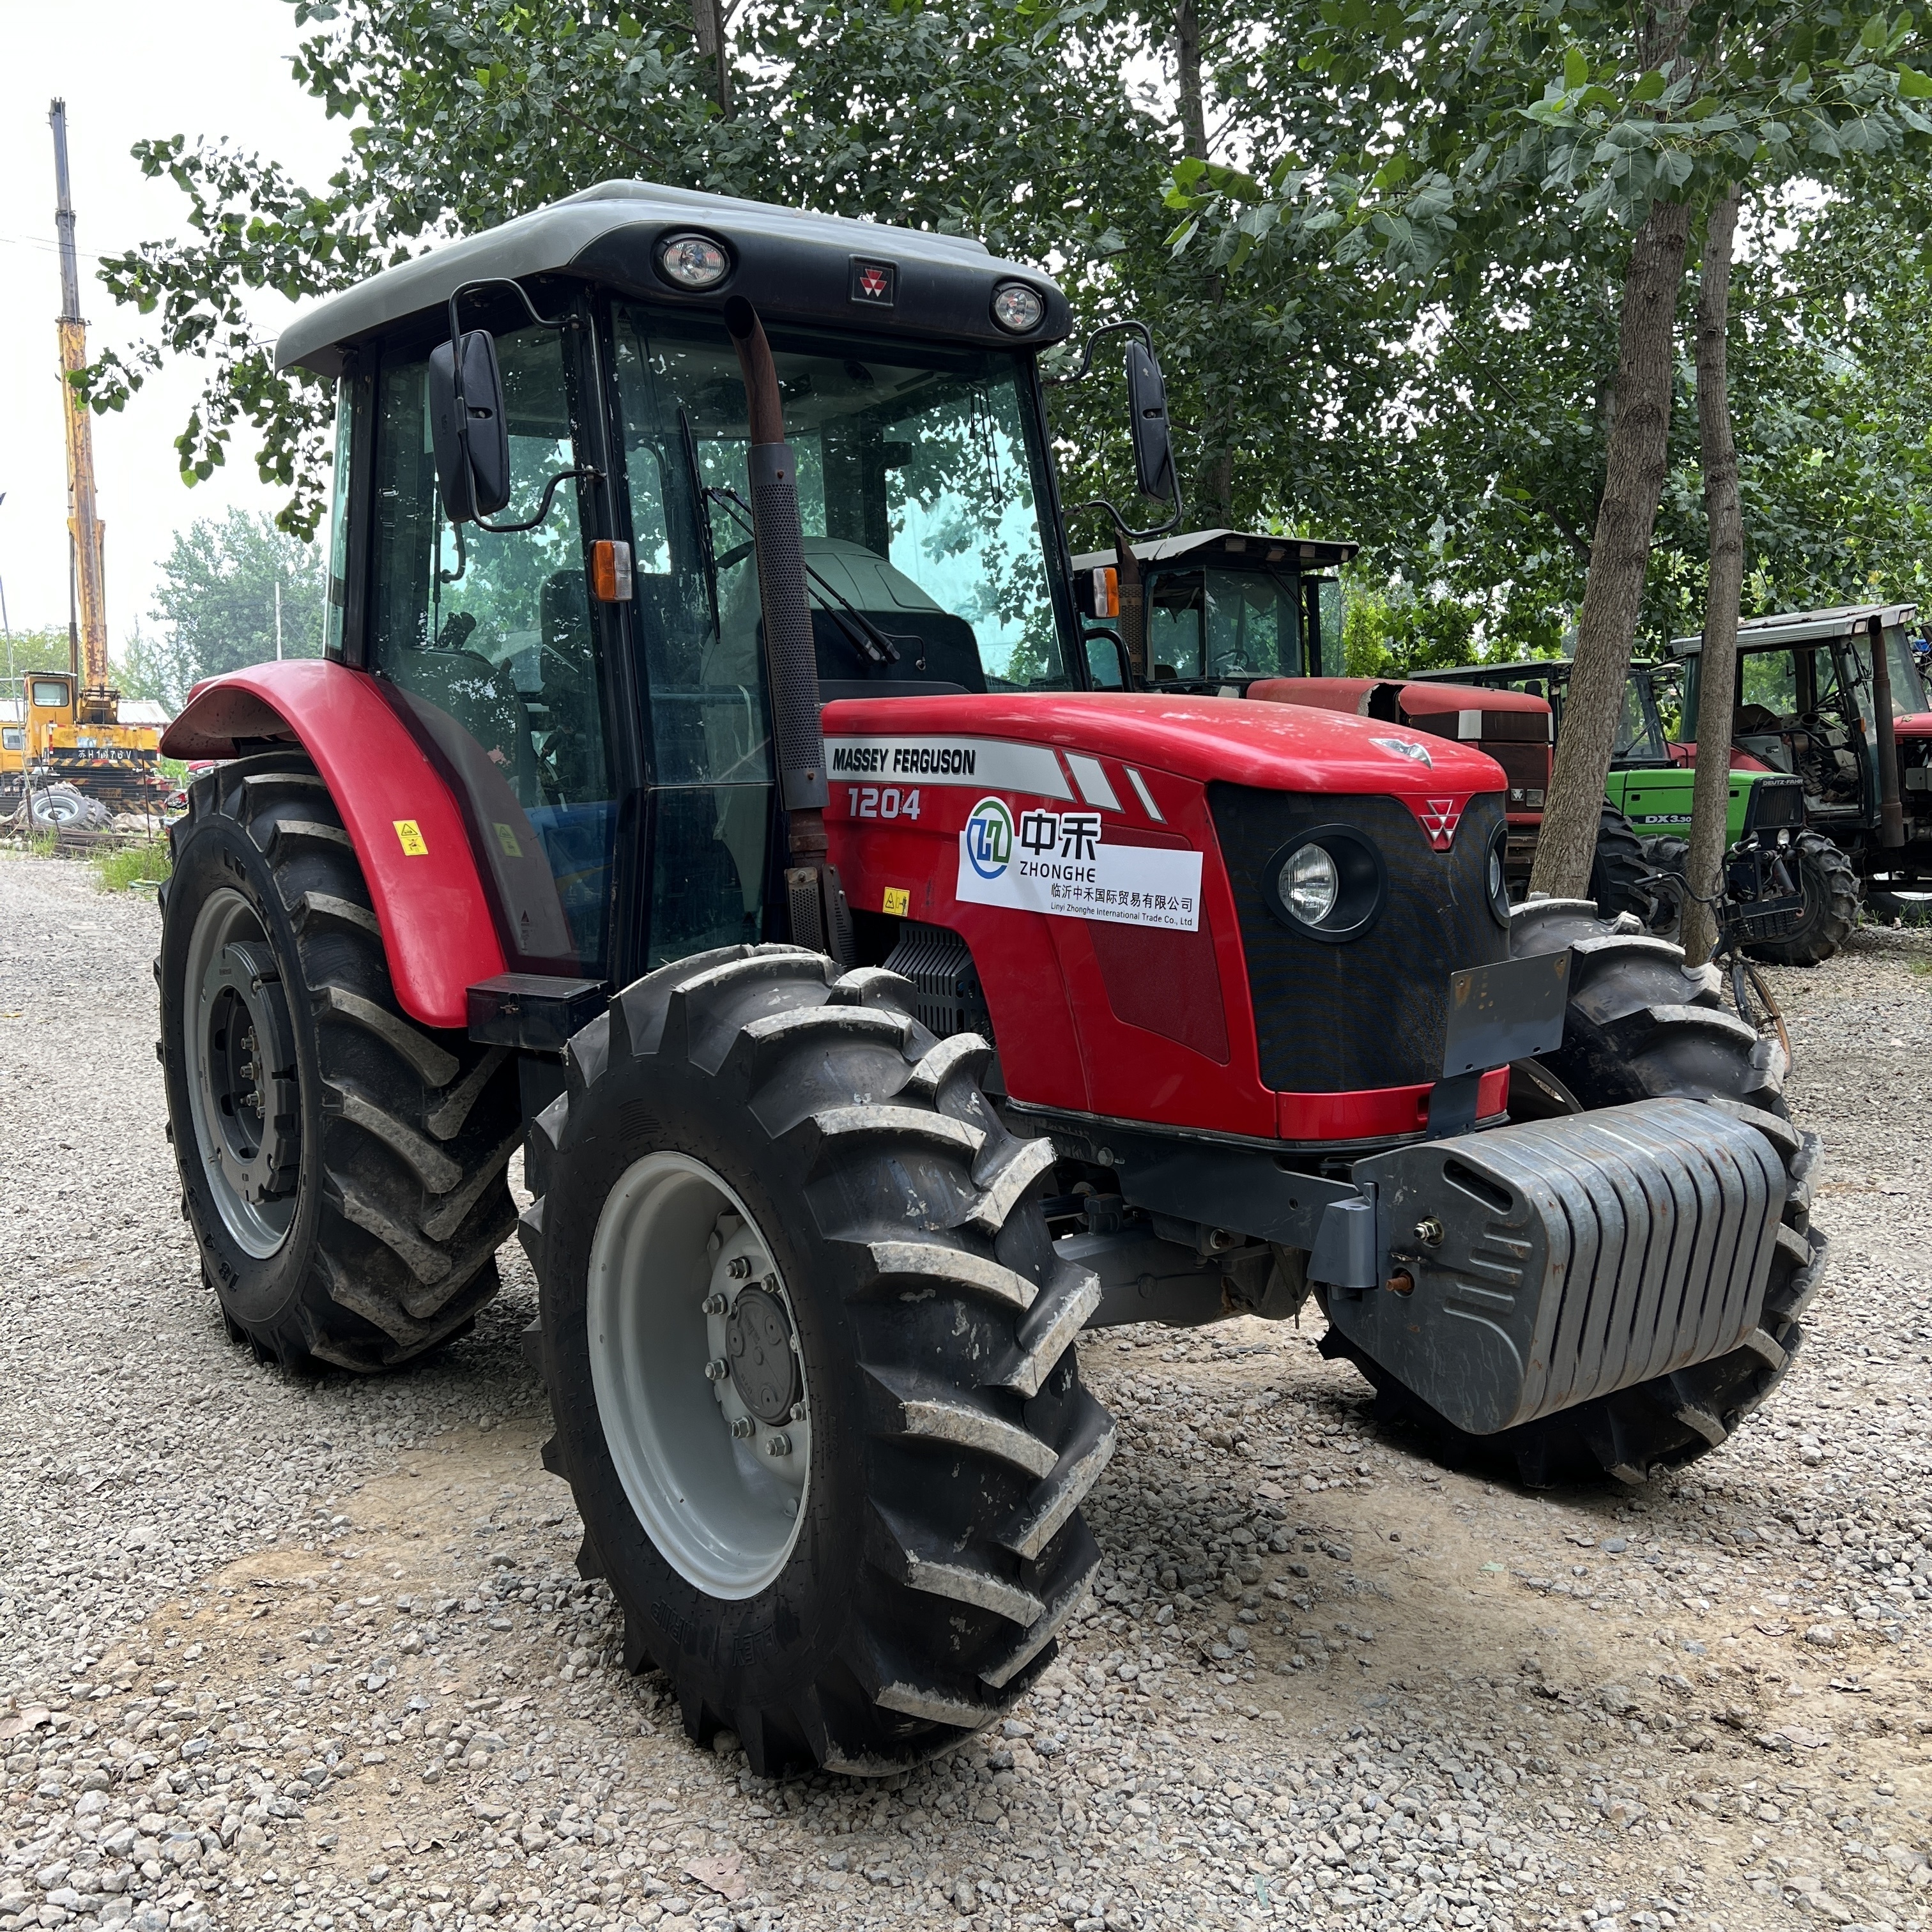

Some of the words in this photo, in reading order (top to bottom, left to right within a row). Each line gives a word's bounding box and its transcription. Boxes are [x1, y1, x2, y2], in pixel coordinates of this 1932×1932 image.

[832, 747, 889, 772] MASSEY
[893, 748, 976, 775] FERGUSON
[848, 788, 920, 820] 1204
[1021, 813, 1098, 861] 中禾
[1020, 861, 1096, 883] ZHONGHE
[1051, 883, 1193, 913] 临沂中禾国际贸易有限公司
[1051, 902, 1065, 912] Linyi
[1066, 904, 1095, 915] Zhonghe
[1096, 908, 1140, 920] International
[1142, 912, 1162, 923] Trade
[1164, 916, 1178, 926] Co.,
[1180, 917, 1193, 926] Ltd
